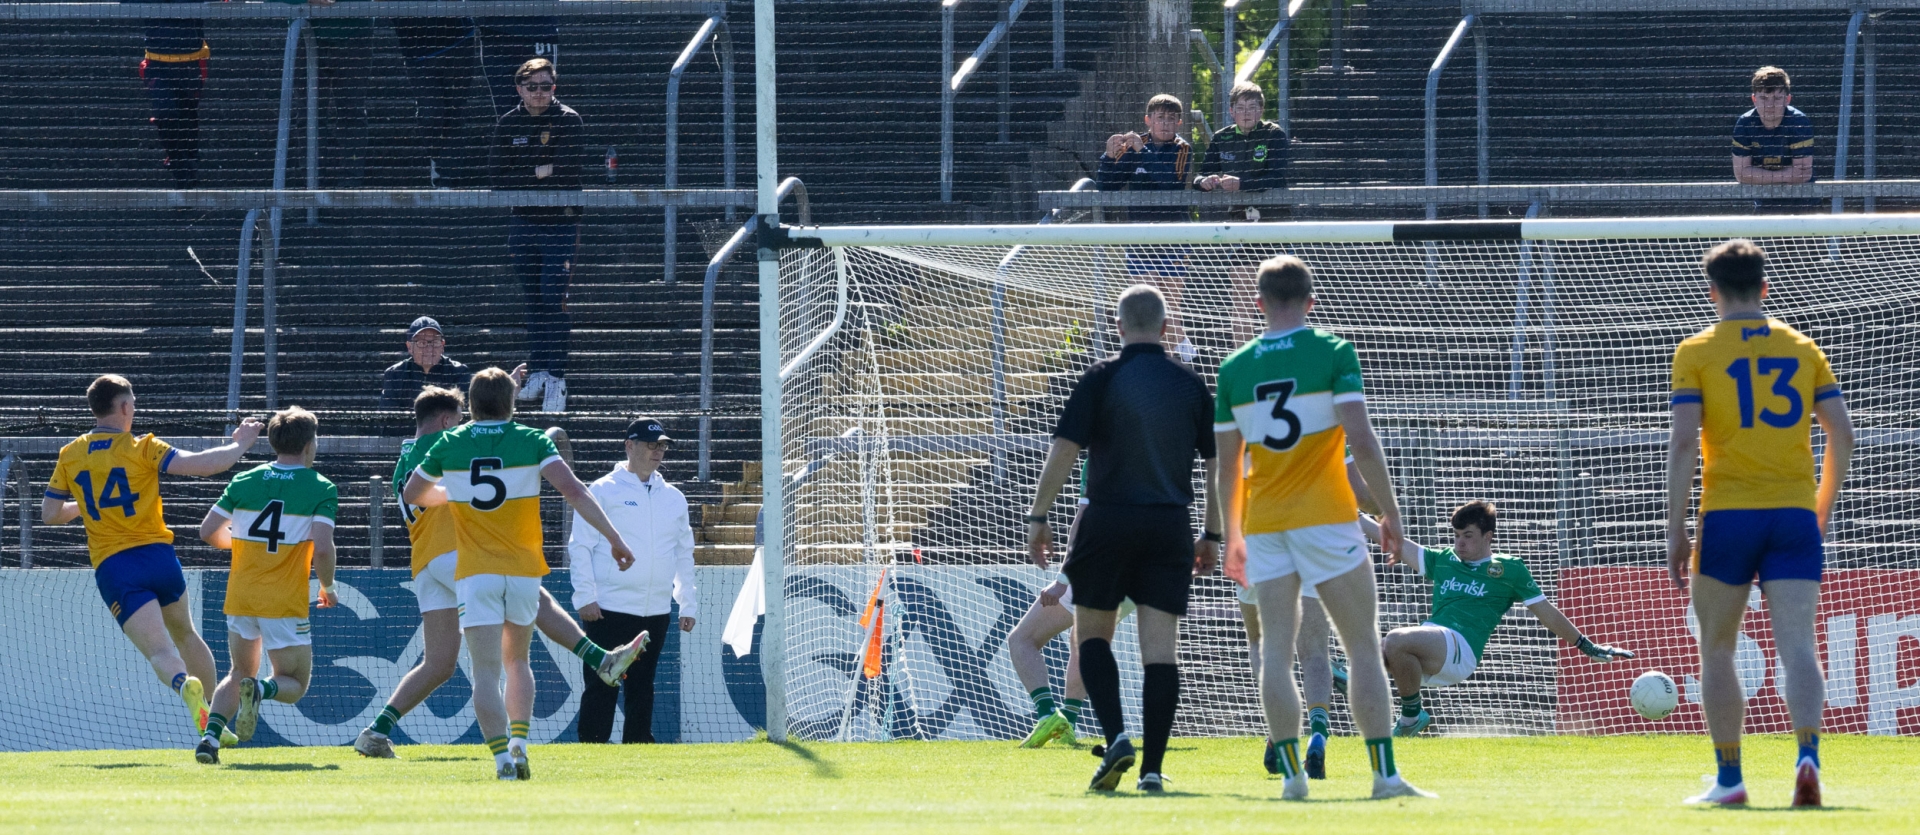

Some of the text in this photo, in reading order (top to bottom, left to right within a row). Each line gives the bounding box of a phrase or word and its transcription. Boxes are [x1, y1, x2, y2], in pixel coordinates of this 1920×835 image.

[1254, 378, 1302, 452] 3
[1725, 357, 1804, 428] 13
[74, 467, 139, 521] 14
[470, 457, 507, 512] 5
[247, 499, 285, 554] 4
[1440, 577, 1488, 597] glenisk
